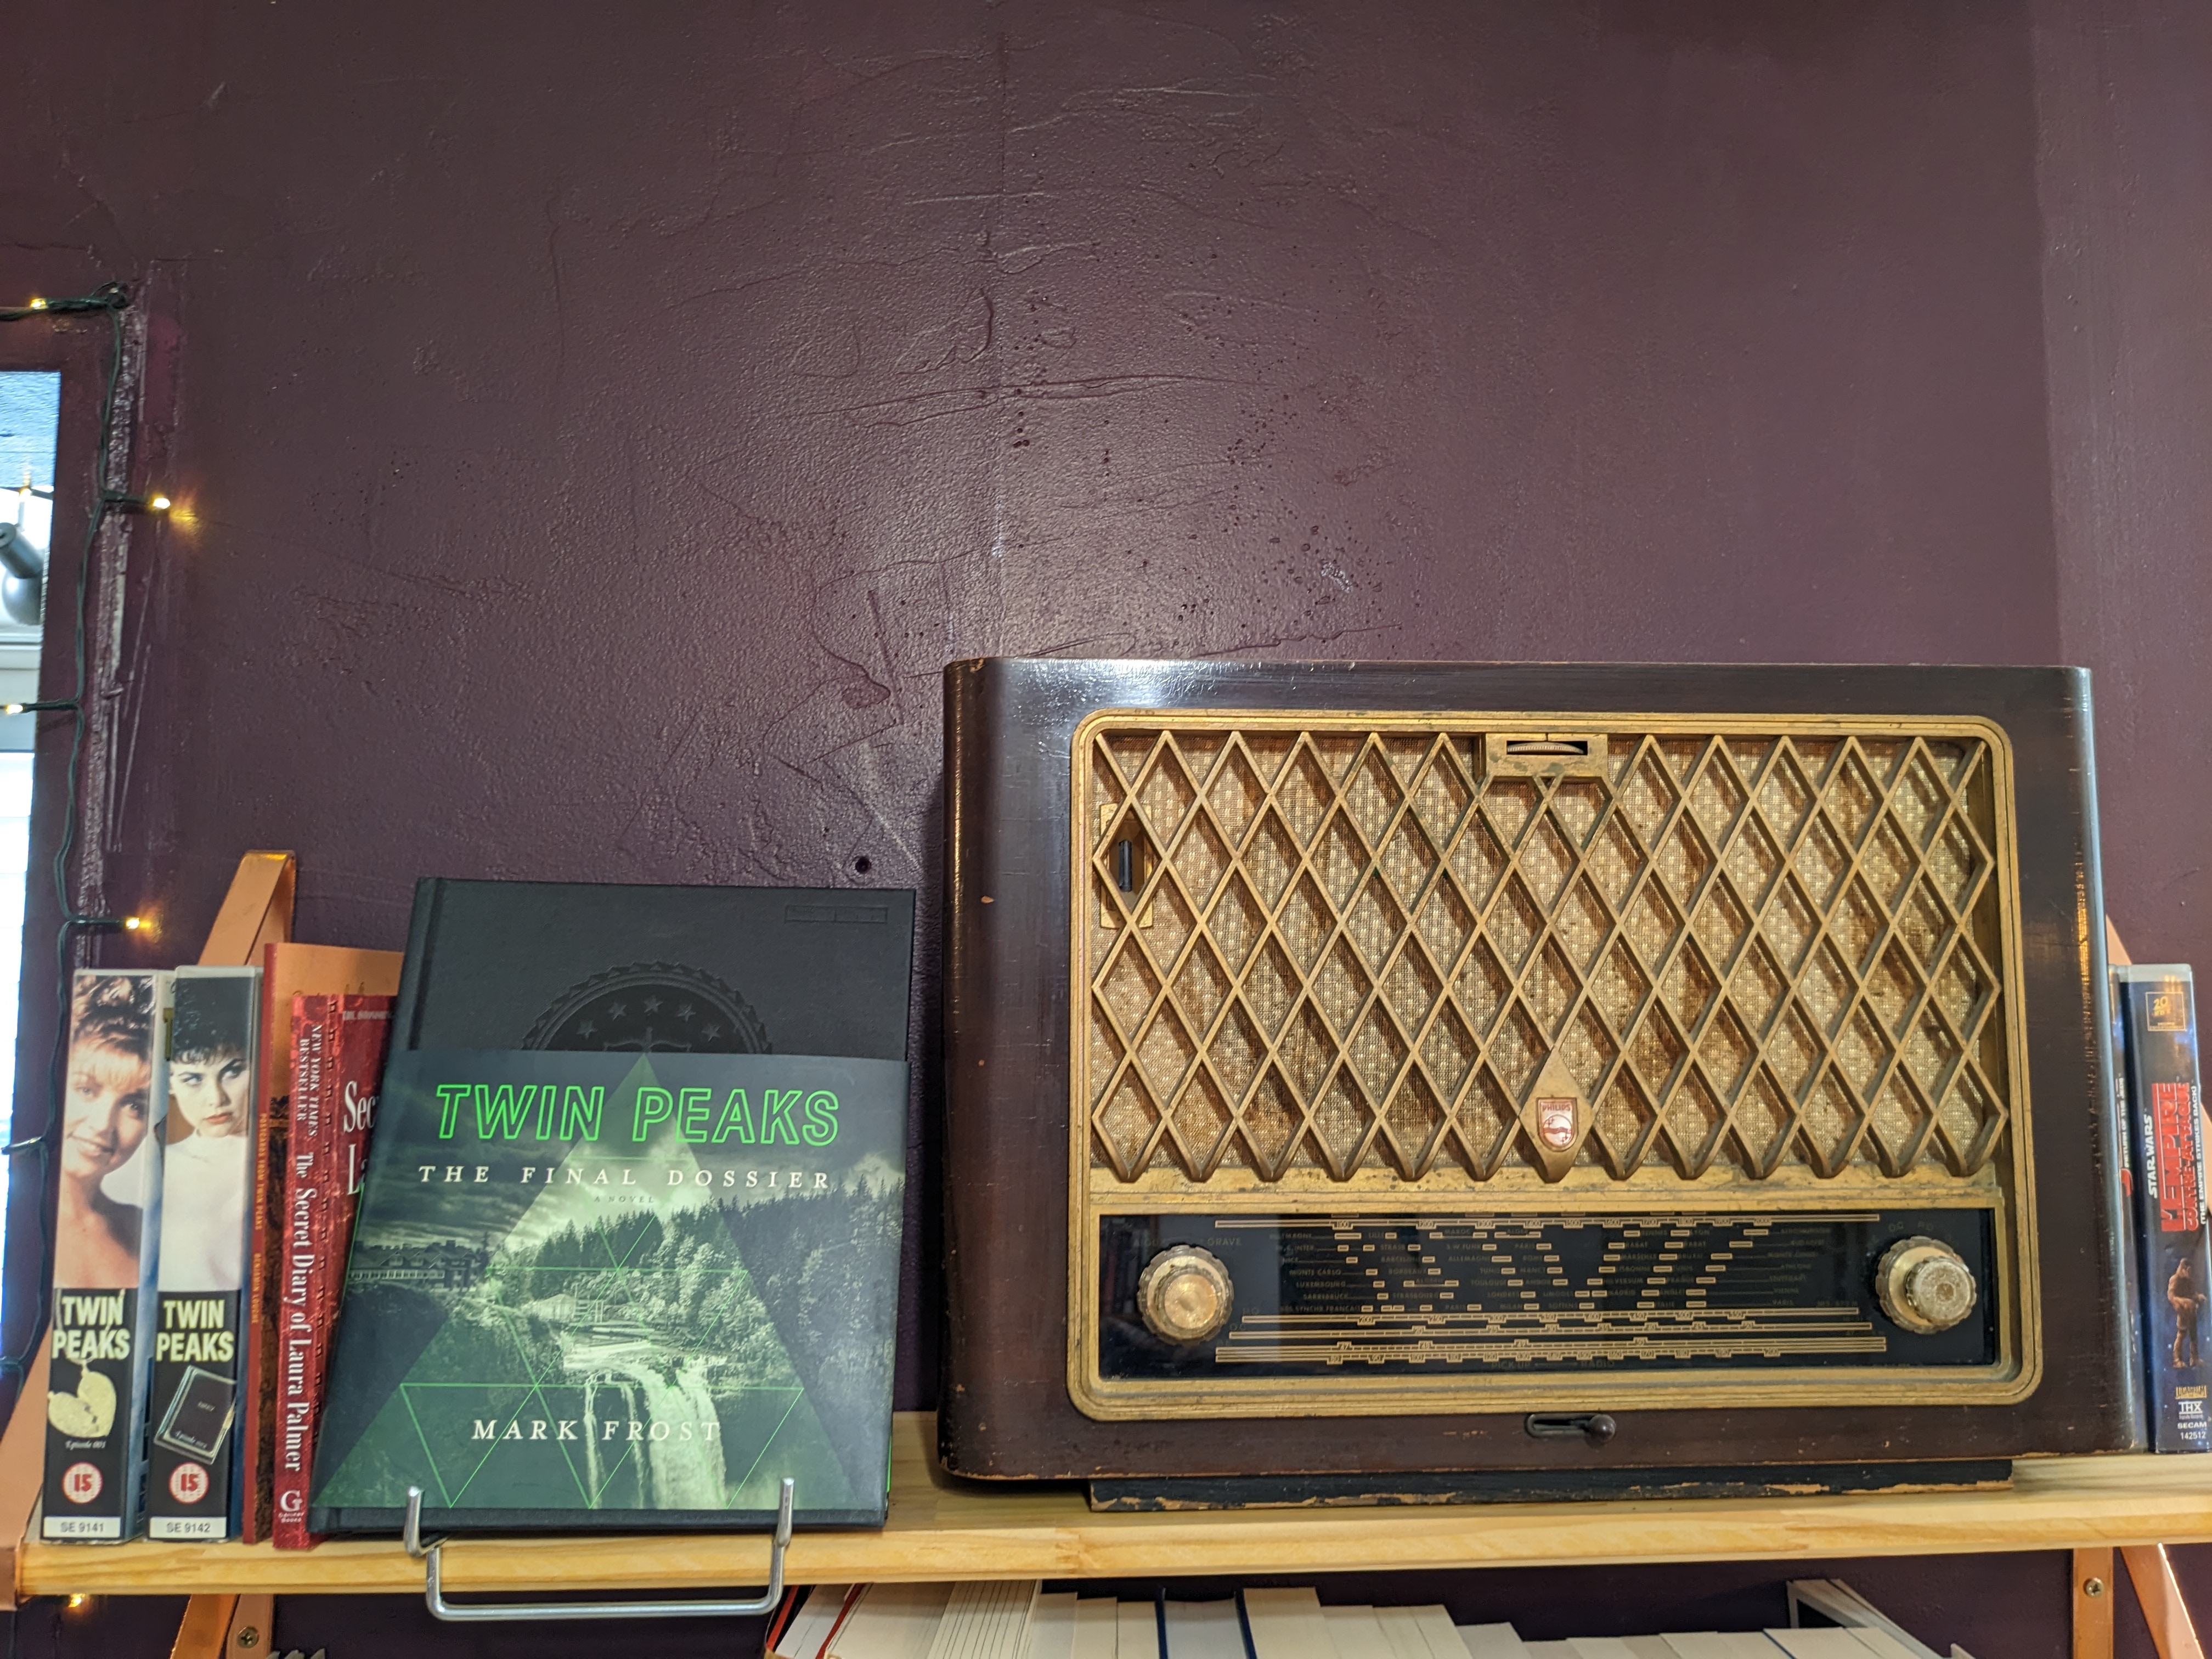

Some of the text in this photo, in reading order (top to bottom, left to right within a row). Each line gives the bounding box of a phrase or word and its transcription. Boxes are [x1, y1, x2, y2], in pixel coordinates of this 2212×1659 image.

[297, 1039, 310, 1121] BESTSELLER
[308, 1024, 322, 1136] NEW YORK TIMES
[436, 1084, 839, 1147] TWIN PEAKS
[1542, 1103, 1571, 1111] PHILIPS
[2191, 1085, 2199, 1116] BACK)
[2193, 1118, 2202, 1160] STRIKES
[2143, 1114, 2158, 1199] STAR WARS
[2177, 1082, 2199, 1232] CONTRE-ATTAQUE
[419, 1165, 830, 1189] THE FINAL DOSSIER
[2196, 1161, 2204, 1200] EMPIRE
[255, 1205, 263, 1230] PEAKS
[1317, 1268, 1342, 1276] CARLO
[61, 1296, 125, 1326] TWIN
[163, 1299, 225, 1329] TWIN
[283, 1152, 318, 1471] The Secret Diary of Laura Palmer
[52, 1328, 131, 1361] PEAKS
[156, 1330, 235, 1362] PEAKS
[2178, 1401, 2203, 1414] THX
[471, 1419, 721, 1441] MARK FROST
[2177, 1421, 2207, 1430] SECAM
[2180, 1431, 2207, 1440] 142512
[74, 1474, 93, 1492] 15
[180, 1473, 201, 1492] 15
[61, 1521, 104, 1533] SE 9141
[166, 1522, 211, 1533] SE 9142
